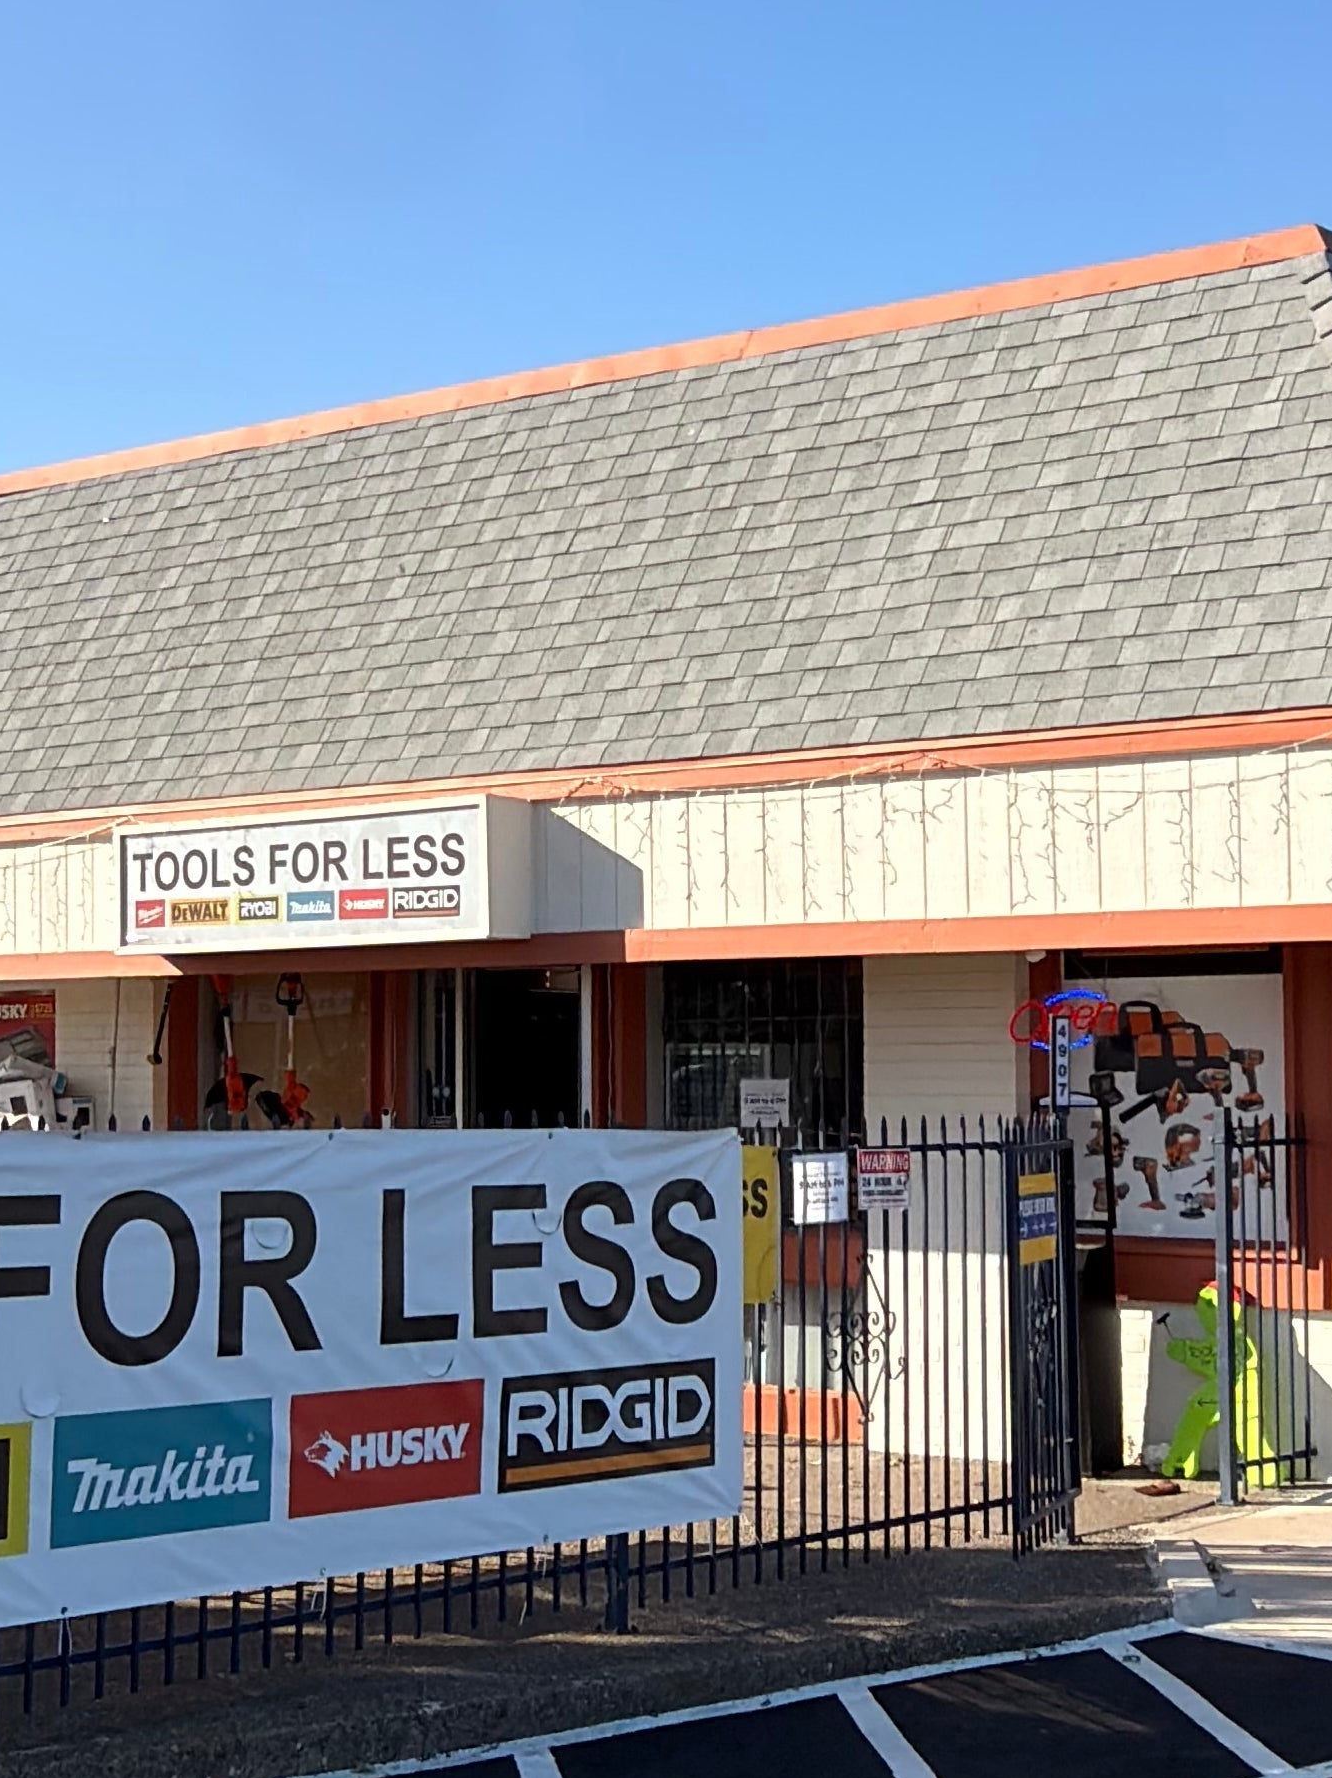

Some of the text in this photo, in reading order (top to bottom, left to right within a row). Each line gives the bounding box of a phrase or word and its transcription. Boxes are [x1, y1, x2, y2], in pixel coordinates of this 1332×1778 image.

[132, 833, 466, 892] TOOLS FOR LESS
[240, 900, 278, 917] RYOBI
[394, 889, 459, 910] RIDGID
[1057, 1024, 1068, 1097] 4907
[861, 1153, 909, 1171] WARNING
[379, 1178, 718, 1345] LESS
[506, 1374, 712, 1457] RIDGID
[349, 1423, 469, 1472] HUSKY
[67, 1445, 260, 1515] Makita
